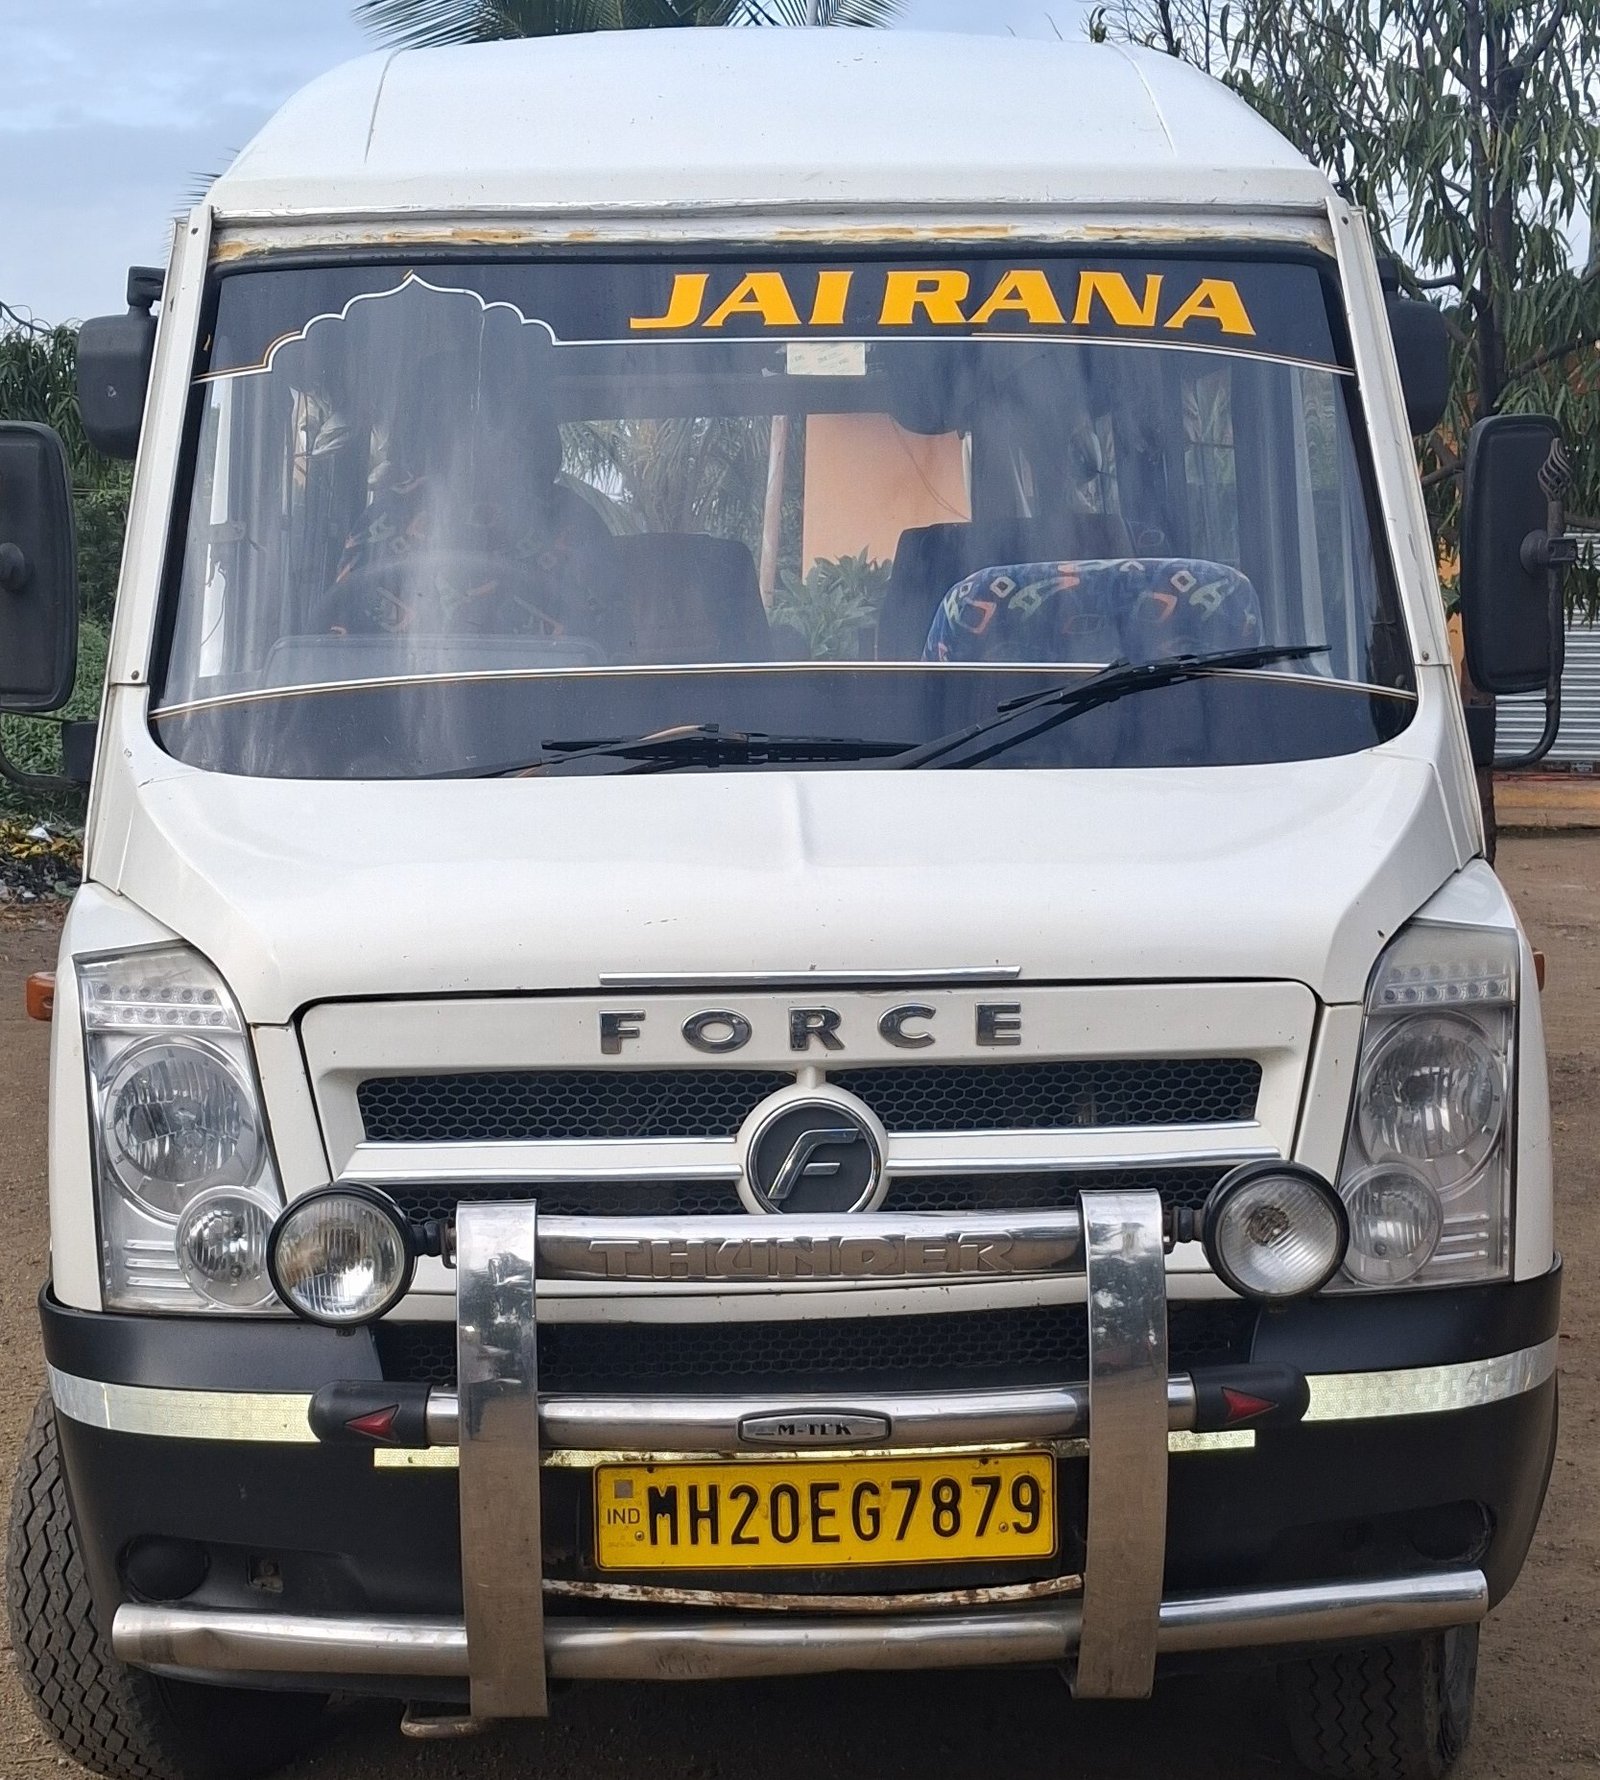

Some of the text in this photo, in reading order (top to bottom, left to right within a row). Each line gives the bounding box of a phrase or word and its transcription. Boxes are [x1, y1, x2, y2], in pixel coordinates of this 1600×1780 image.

[629, 269, 1256, 336] JAI RANA
[599, 1001, 1022, 1055] FORCE
[588, 1232, 1022, 1279] THUNDER
[606, 1507, 641, 1525] IND
[647, 1473, 1042, 1547] MH20EG7879
